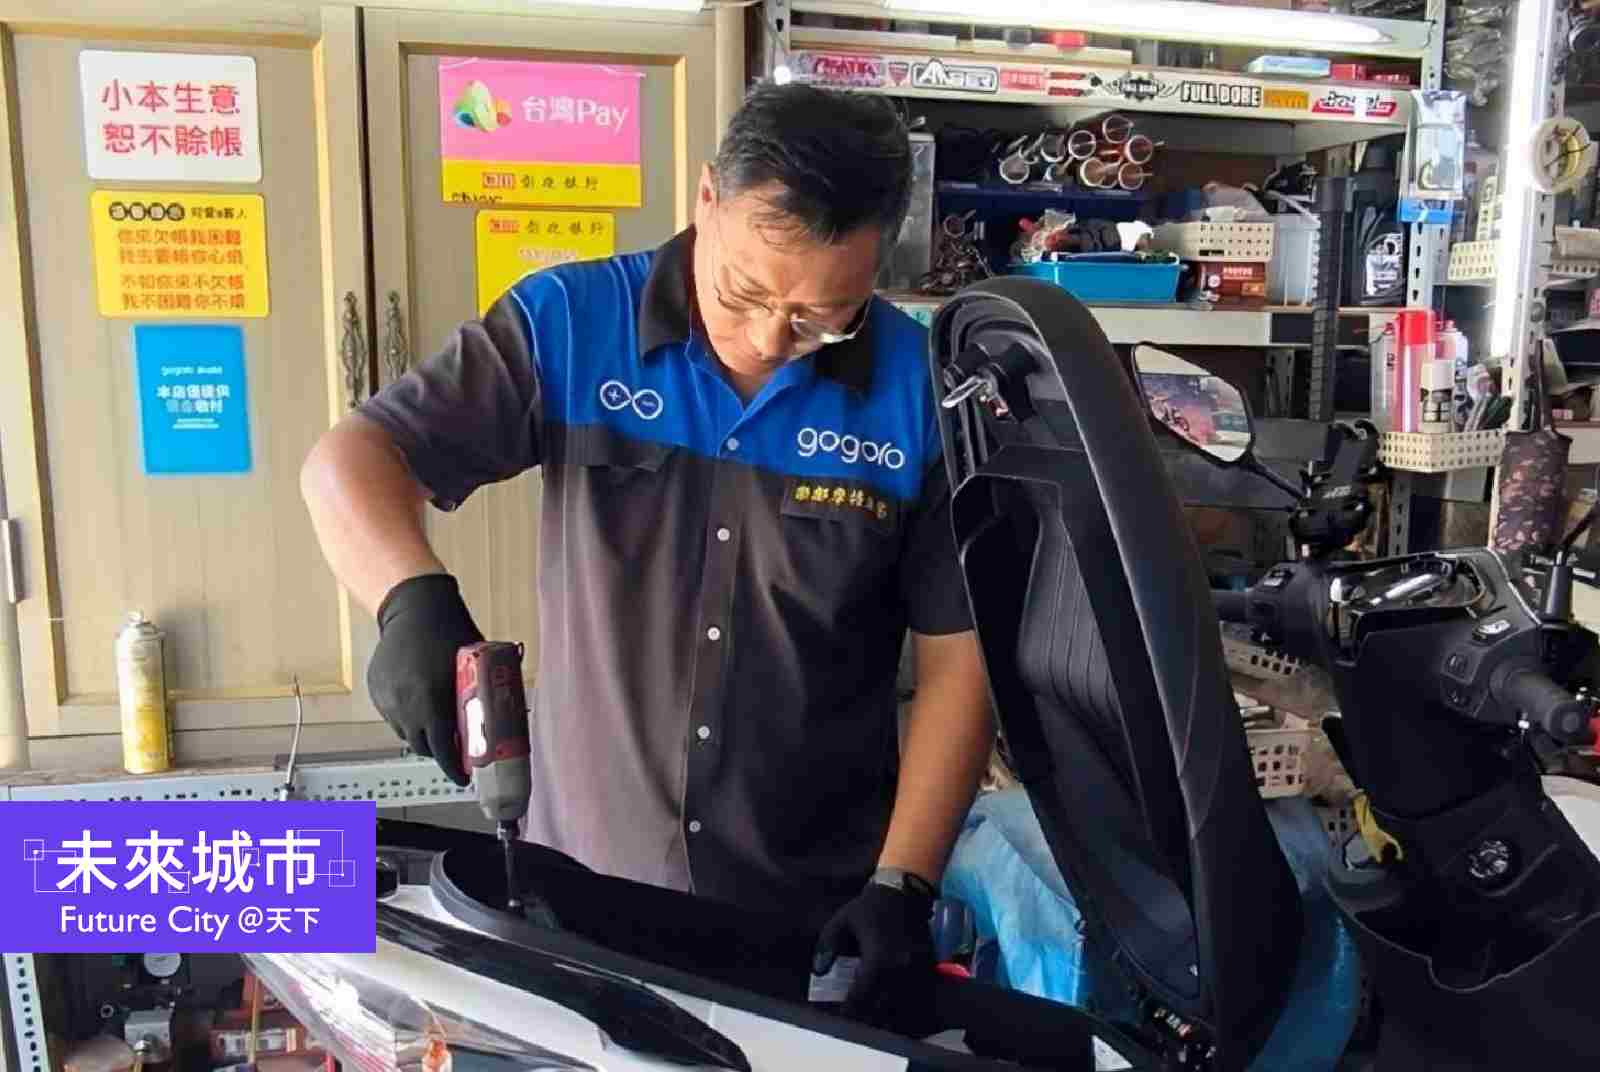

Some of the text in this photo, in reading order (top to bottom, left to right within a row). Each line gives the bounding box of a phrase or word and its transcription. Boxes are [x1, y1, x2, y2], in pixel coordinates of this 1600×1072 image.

[101, 78, 241, 115] 小本生意
[521, 95, 629, 136] 台灣Pay
[102, 122, 243, 157] 恕不賒帳
[797, 428, 905, 470] gogoro
